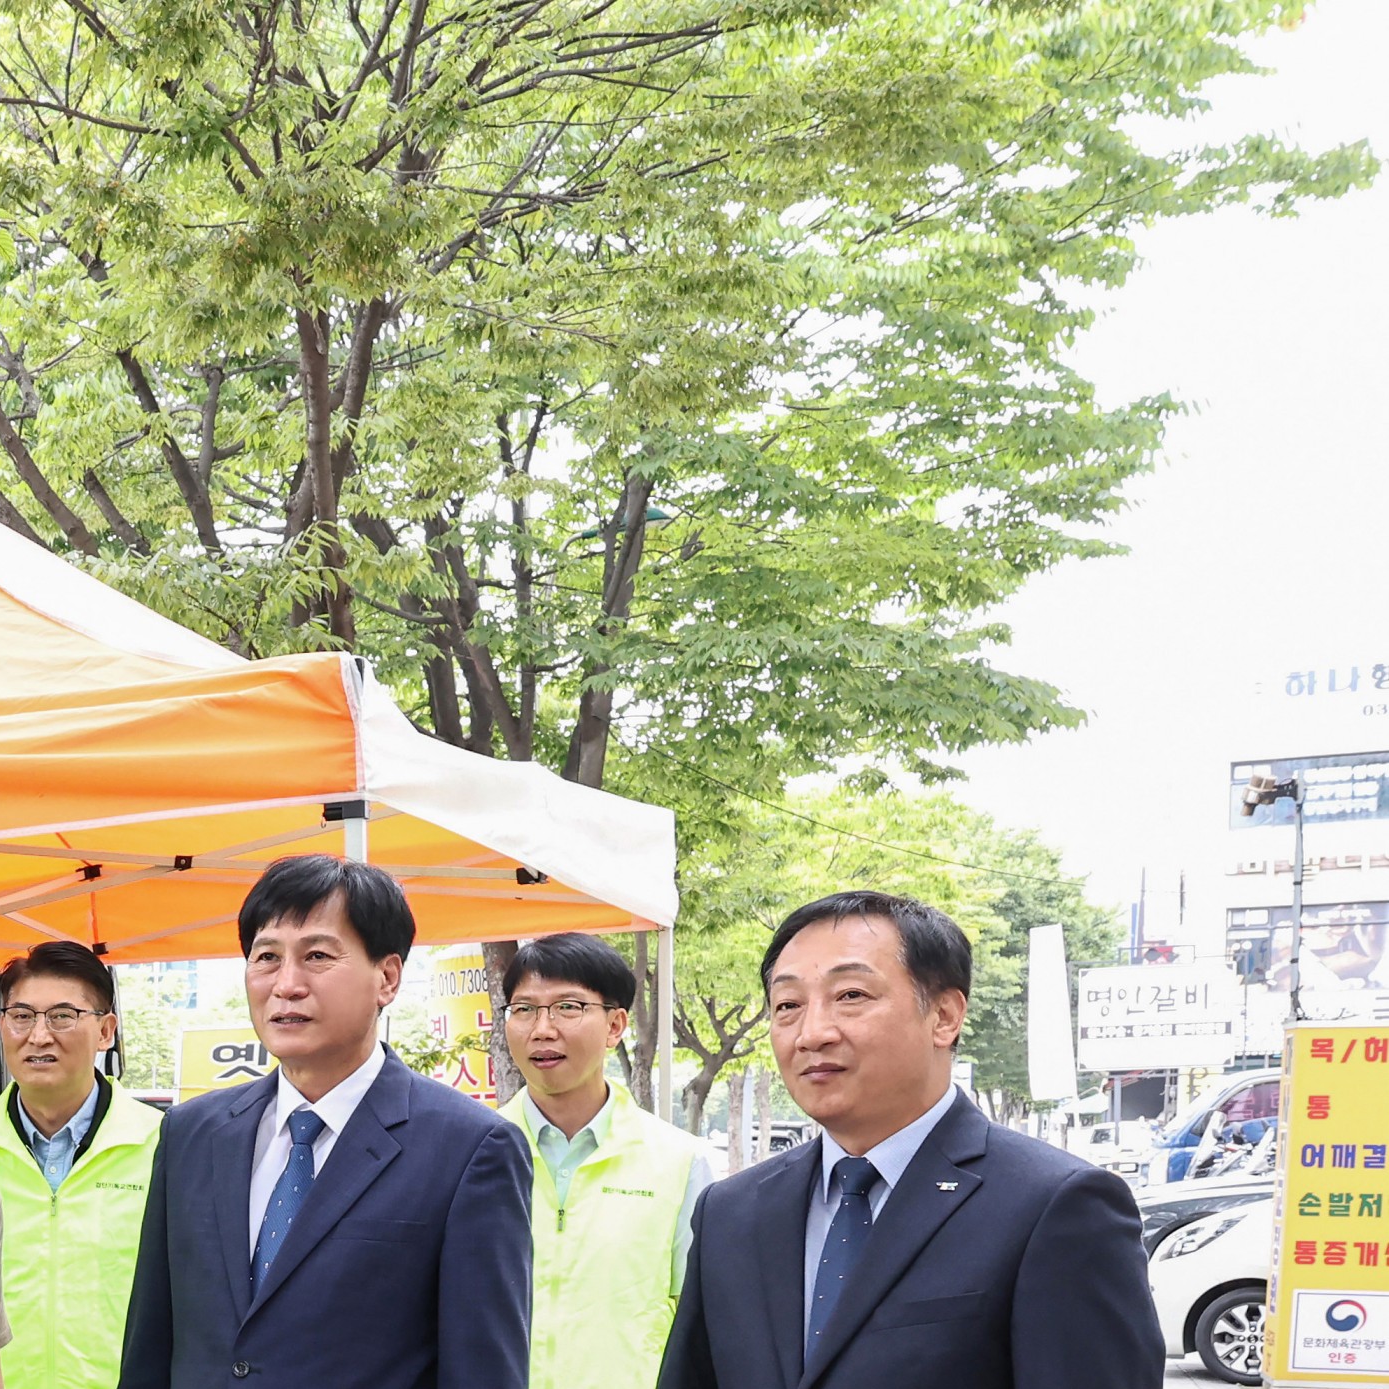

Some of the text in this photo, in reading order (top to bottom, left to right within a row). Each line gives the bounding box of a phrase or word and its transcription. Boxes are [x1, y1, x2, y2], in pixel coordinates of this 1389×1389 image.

[1087, 983, 1208, 1016] 명인갈비
[1307, 1095, 1330, 1120] 통
[1301, 1144, 1386, 1168] 어깨결
[1298, 1193, 1382, 1218] 손발저
[1303, 1338, 1385, 1350] 문화체육관광부
[1328, 1352, 1357, 1364] 인증
